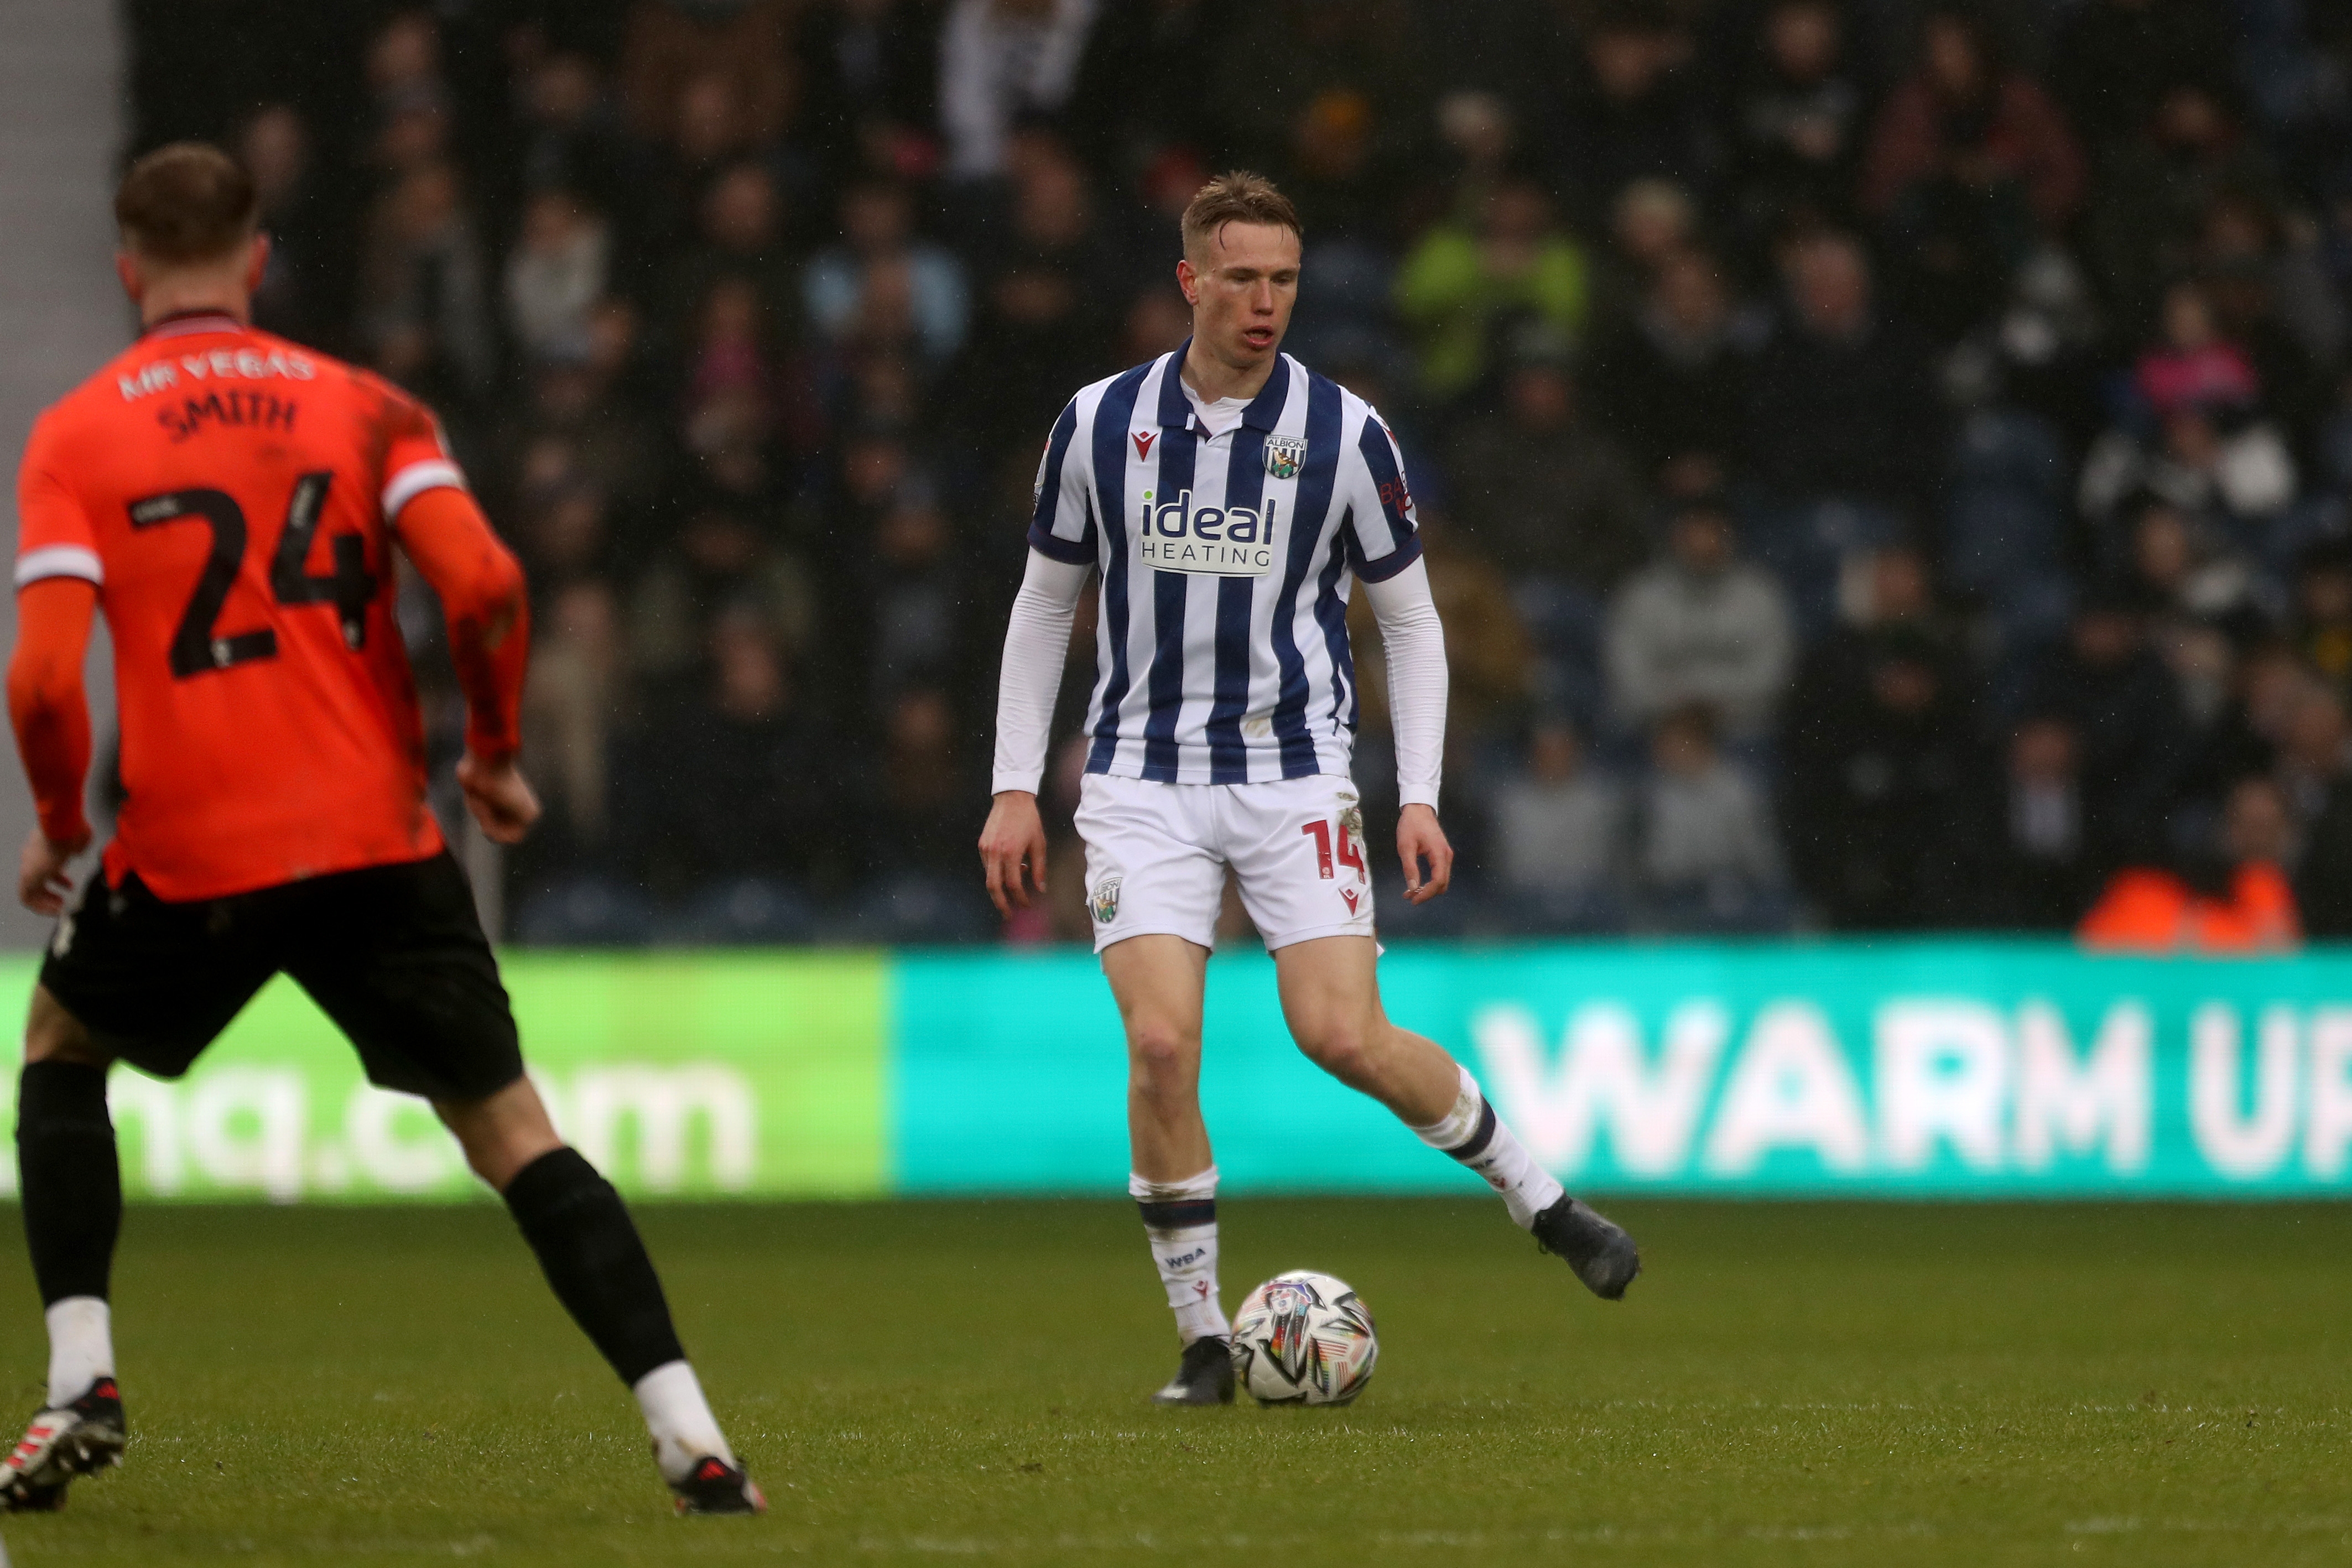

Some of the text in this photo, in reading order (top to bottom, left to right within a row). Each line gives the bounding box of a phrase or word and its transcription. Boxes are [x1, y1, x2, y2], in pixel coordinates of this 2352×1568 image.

[117, 346, 316, 402] MR VEGAS
[156, 388, 296, 444] SMITH
[1267, 439, 1304, 449] ALBION
[1142, 491, 1276, 545] ideal
[129, 470, 378, 680] 24
[1142, 542, 1270, 567] HEATING
[1302, 808, 1366, 885] 14
[1474, 997, 2151, 1177] WARM
[1164, 1247, 1206, 1268] WBA
